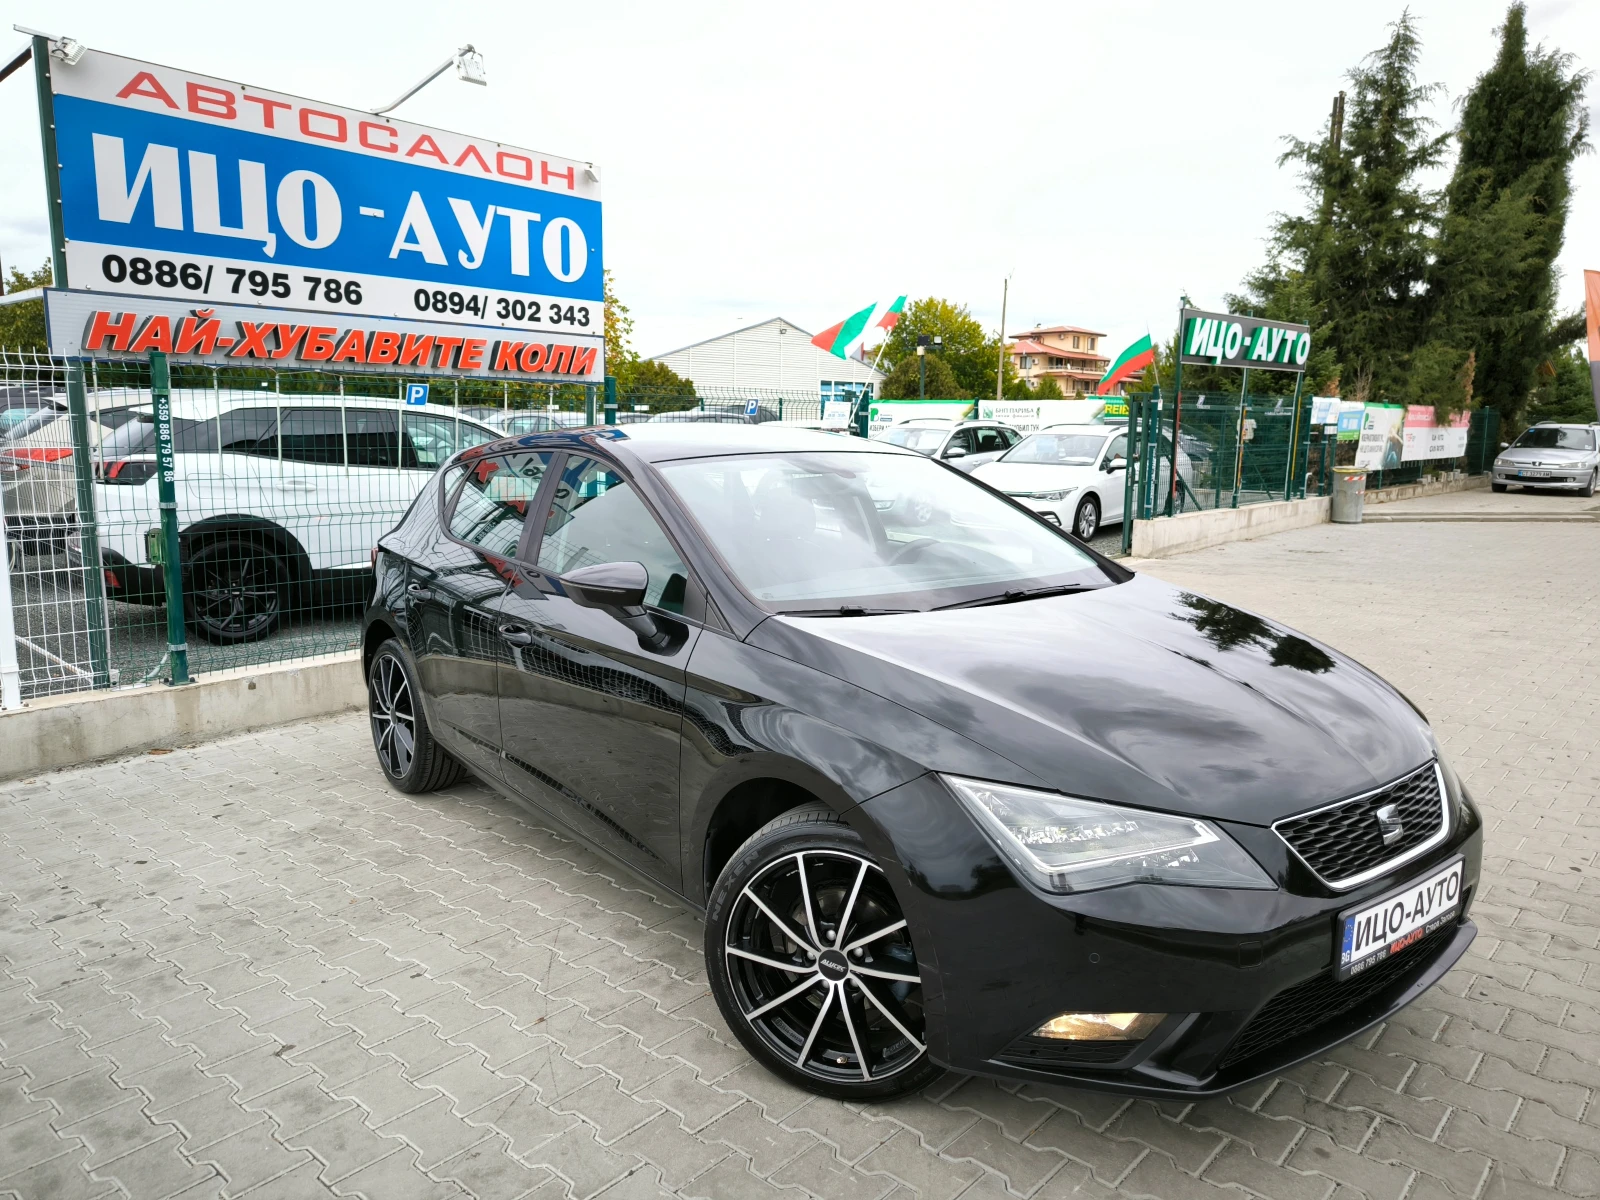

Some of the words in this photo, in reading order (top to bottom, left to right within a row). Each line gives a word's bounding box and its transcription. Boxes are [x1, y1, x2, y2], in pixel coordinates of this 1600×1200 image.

[116, 71, 575, 190] АВТОСАЛОН
[102, 254, 213, 294] 0886/
[225, 267, 291, 299] 795
[303, 276, 363, 305] 786
[413, 289, 488, 320] 0894/
[496, 298, 542, 323] 302
[549, 303, 590, 327] 343
[83, 308, 487, 370] НАЙ-ХУБАВИТЕ
[490, 340, 598, 376] КОЛИ
[1187, 317, 1311, 365] ИЦО-АУТО
[410, 386, 425, 404] P
[158, 398, 169, 420] +359
[160, 423, 170, 440] 886
[161, 443, 171, 454] 79
[162, 457, 172, 467] 57
[164, 471, 174, 482] 86
[1354, 871, 1459, 952] ИЦО-АУТО
[1365, 955, 1376, 968] 795
